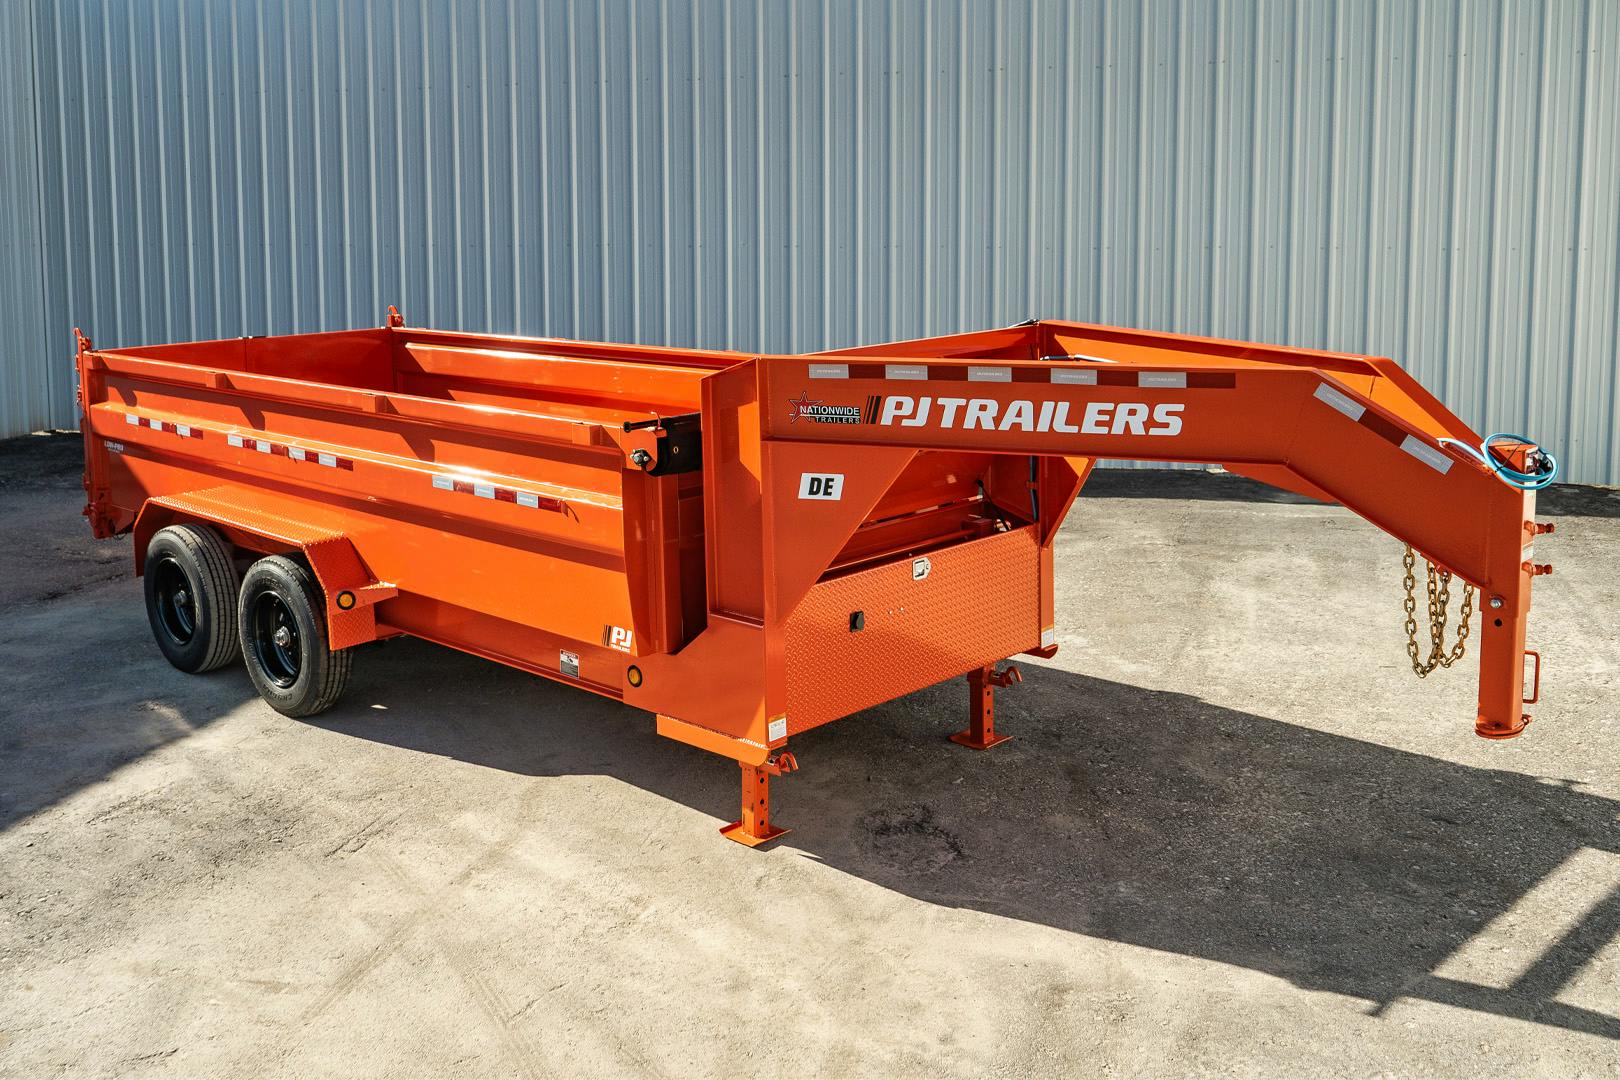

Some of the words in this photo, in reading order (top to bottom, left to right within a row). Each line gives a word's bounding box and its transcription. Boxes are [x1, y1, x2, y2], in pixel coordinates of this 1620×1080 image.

[800, 405, 860, 416] NATIONWIDE
[815, 416, 861, 425] TRAILERS
[808, 477, 835, 497] DE
[611, 626, 633, 648] PJ
